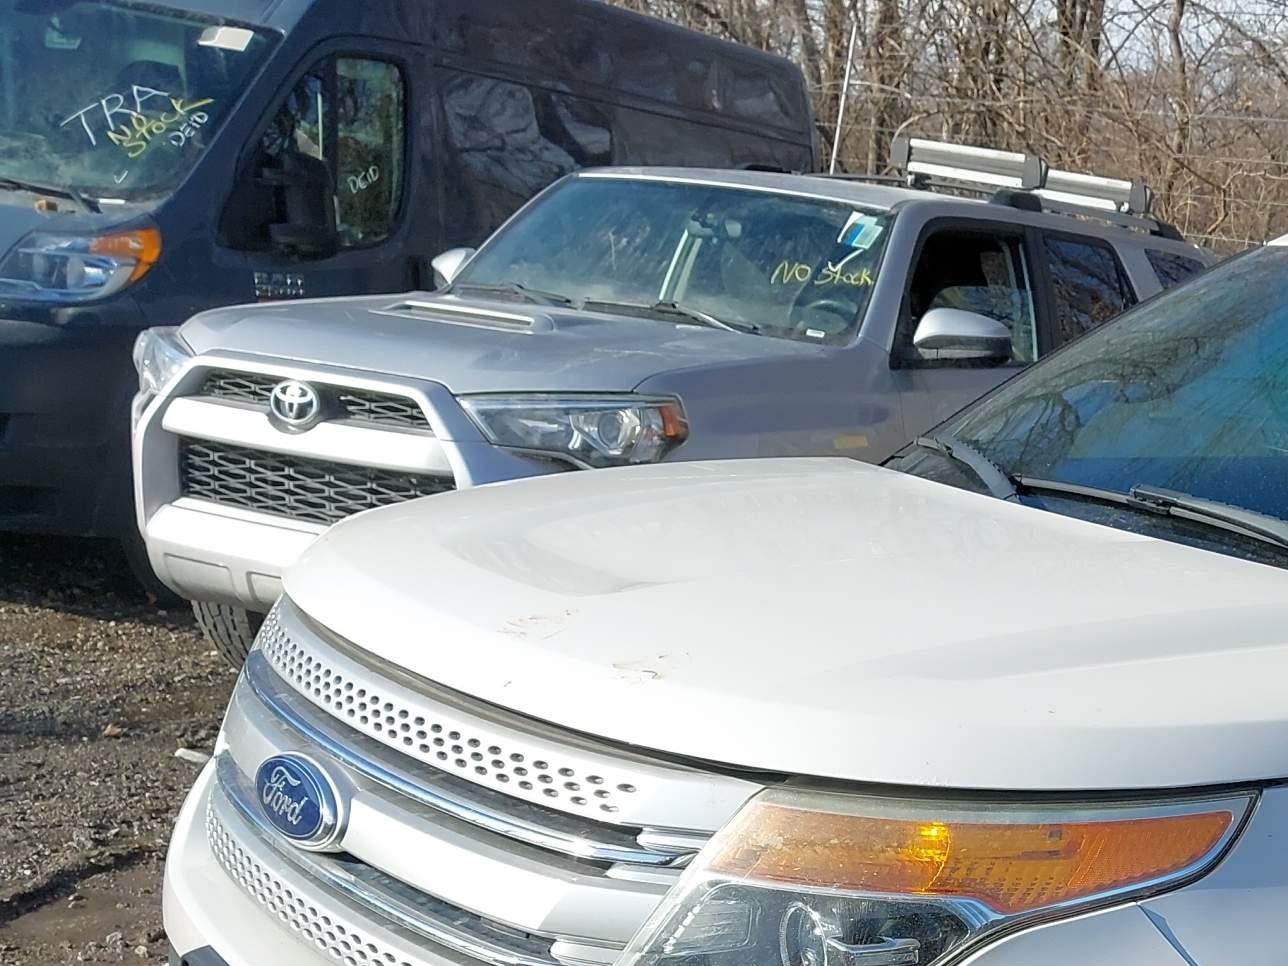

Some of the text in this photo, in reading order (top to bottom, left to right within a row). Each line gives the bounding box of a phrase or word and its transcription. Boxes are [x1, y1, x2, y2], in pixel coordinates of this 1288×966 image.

[60, 84, 169, 146] TRA
[770, 260, 811, 285] NO
[262, 766, 309, 825] Ford
